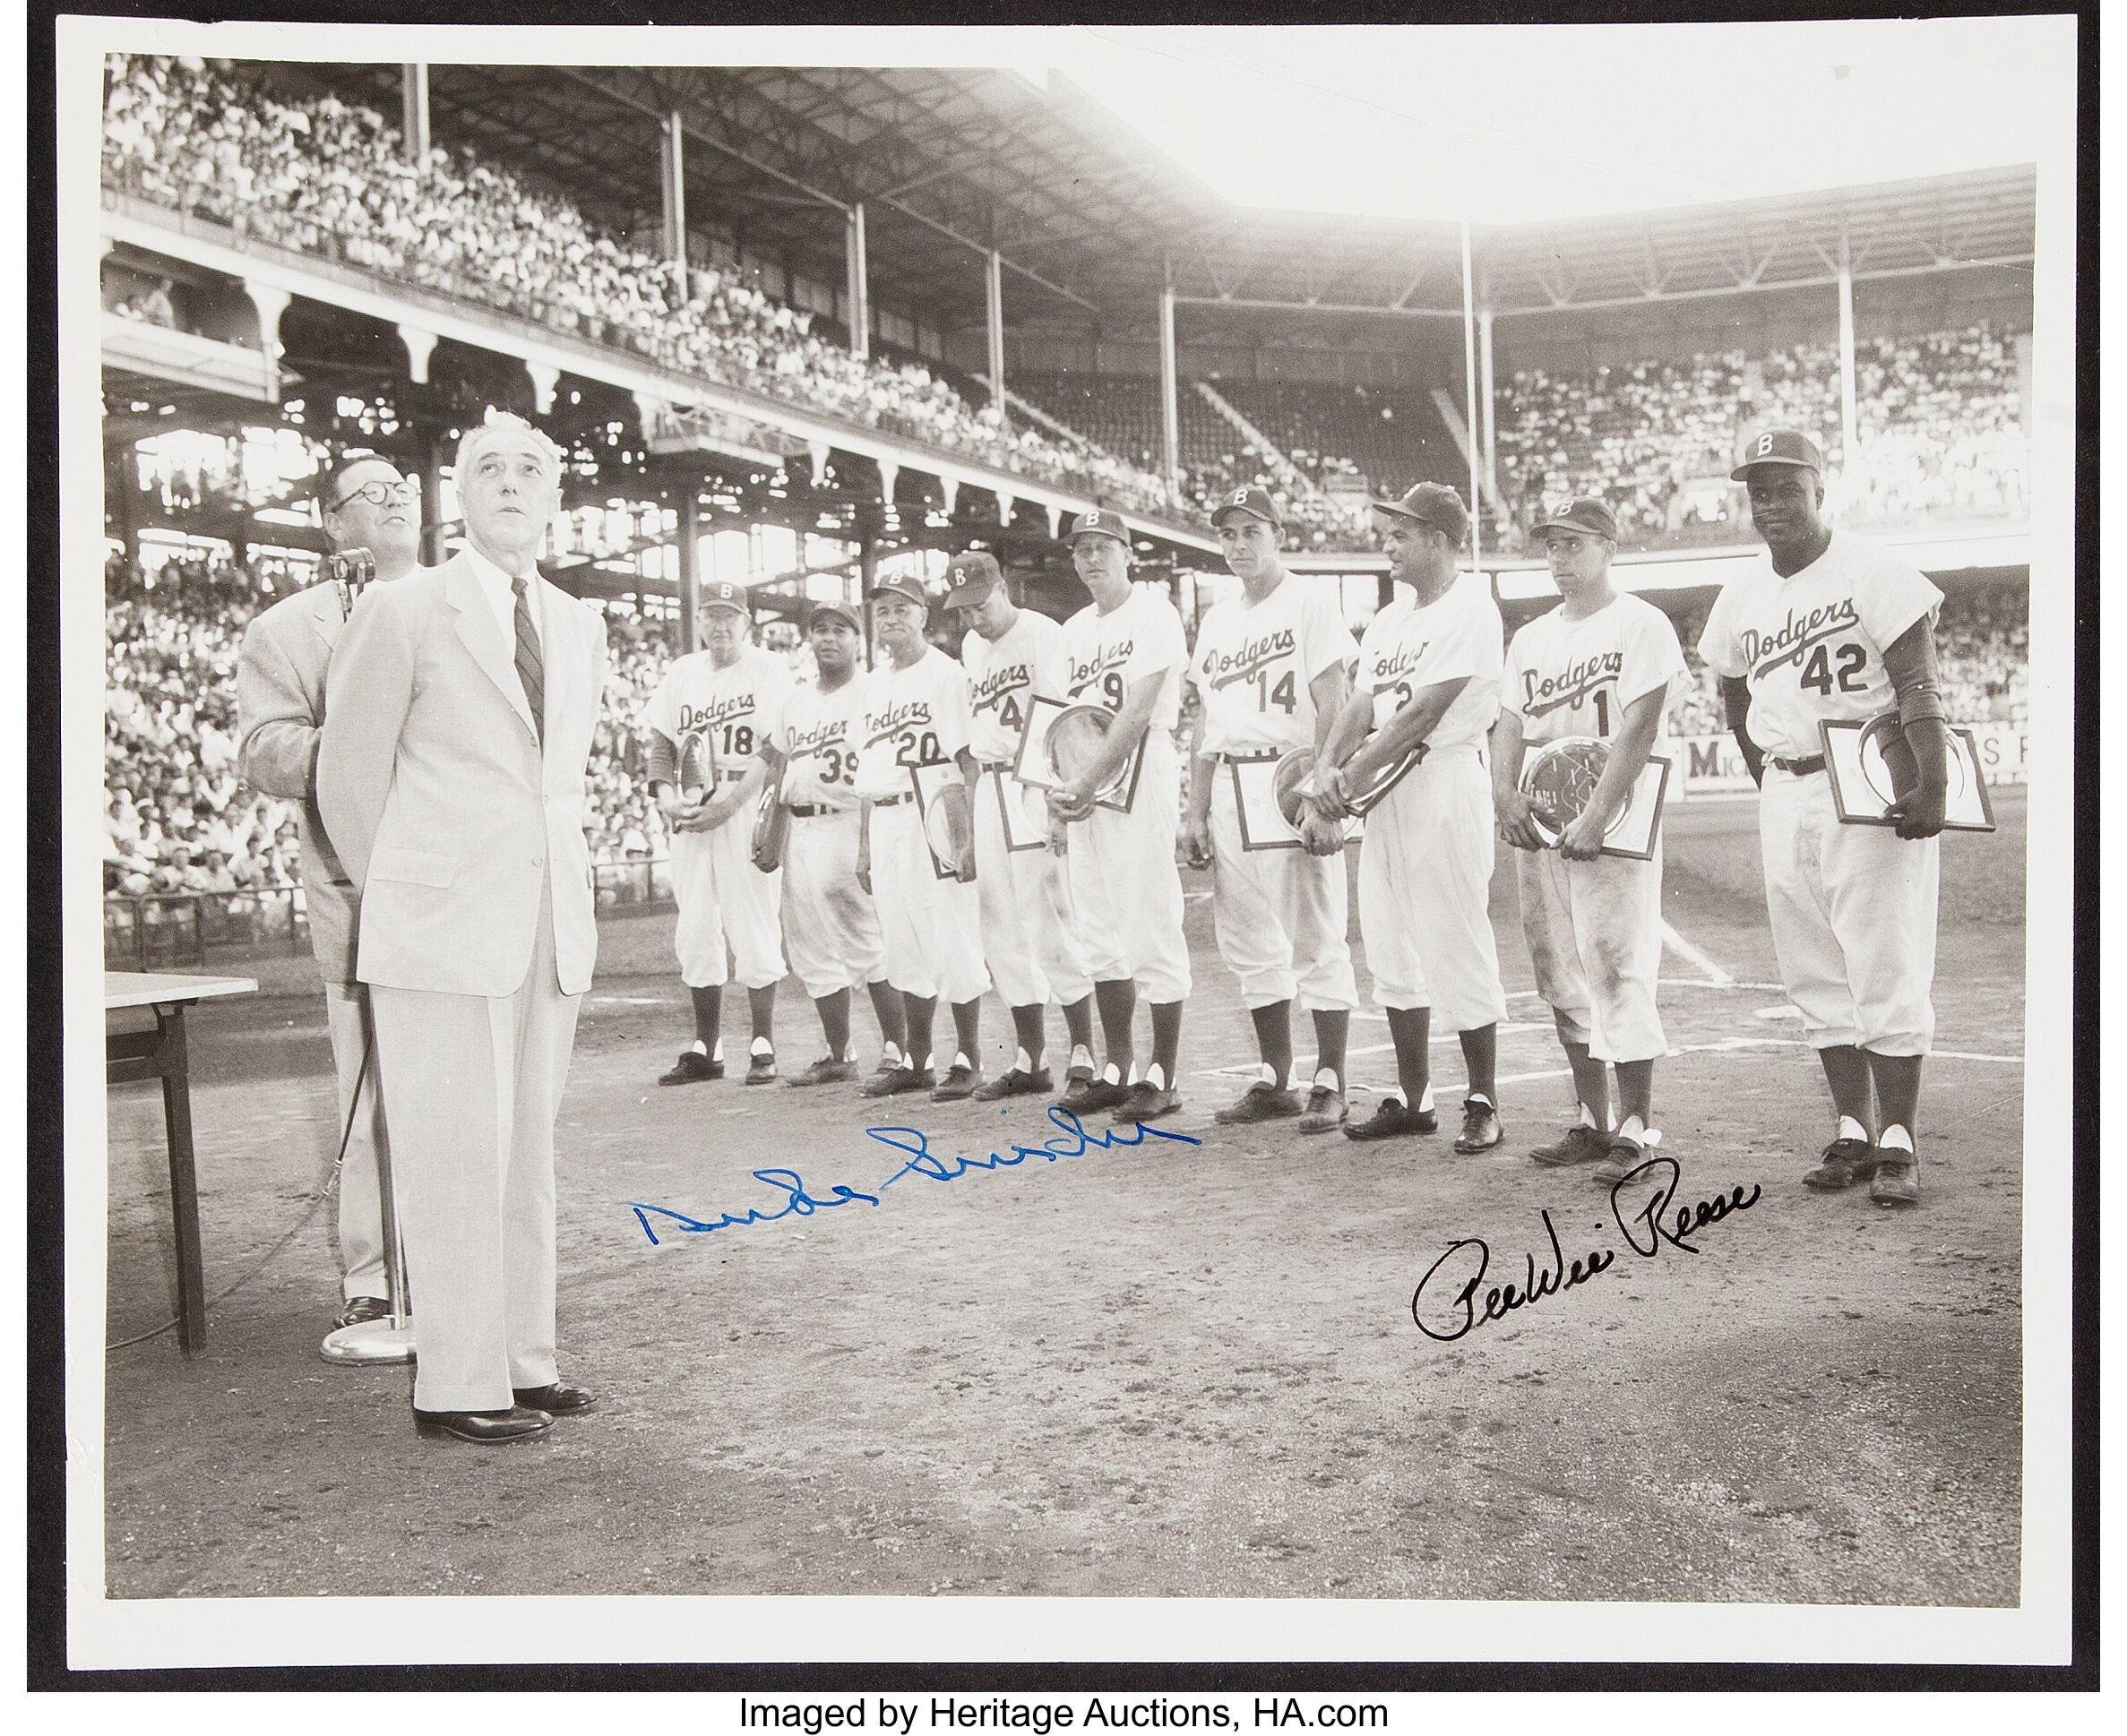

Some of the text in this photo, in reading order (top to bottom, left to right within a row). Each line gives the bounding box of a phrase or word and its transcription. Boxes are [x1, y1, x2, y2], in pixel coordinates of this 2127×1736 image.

[1757, 434, 1773, 457] B
[1233, 488, 1248, 505] B
[1557, 501, 1574, 517] B
[1085, 511, 1100, 527] B
[720, 584, 733, 599] B
[954, 568, 967, 586] B
[1740, 597, 1860, 675] Dodgers
[1202, 629, 1296, 689] Dodgers
[1800, 643, 1870, 696] 42
[1103, 672, 1124, 714] 9
[1256, 670, 1297, 715] 14
[1395, 682, 1413, 714] 2
[1521, 652, 1623, 713] Dodgers
[676, 692, 756, 735] Dodgers
[999, 695, 1025, 733] 4
[1593, 689, 1610, 738] 1
[723, 724, 754, 756] 18
[785, 719, 849, 760] Dodger
[896, 732, 941, 766] 20
[819, 748, 860, 786] 39
[1610, 1157, 1761, 1258] Reese
